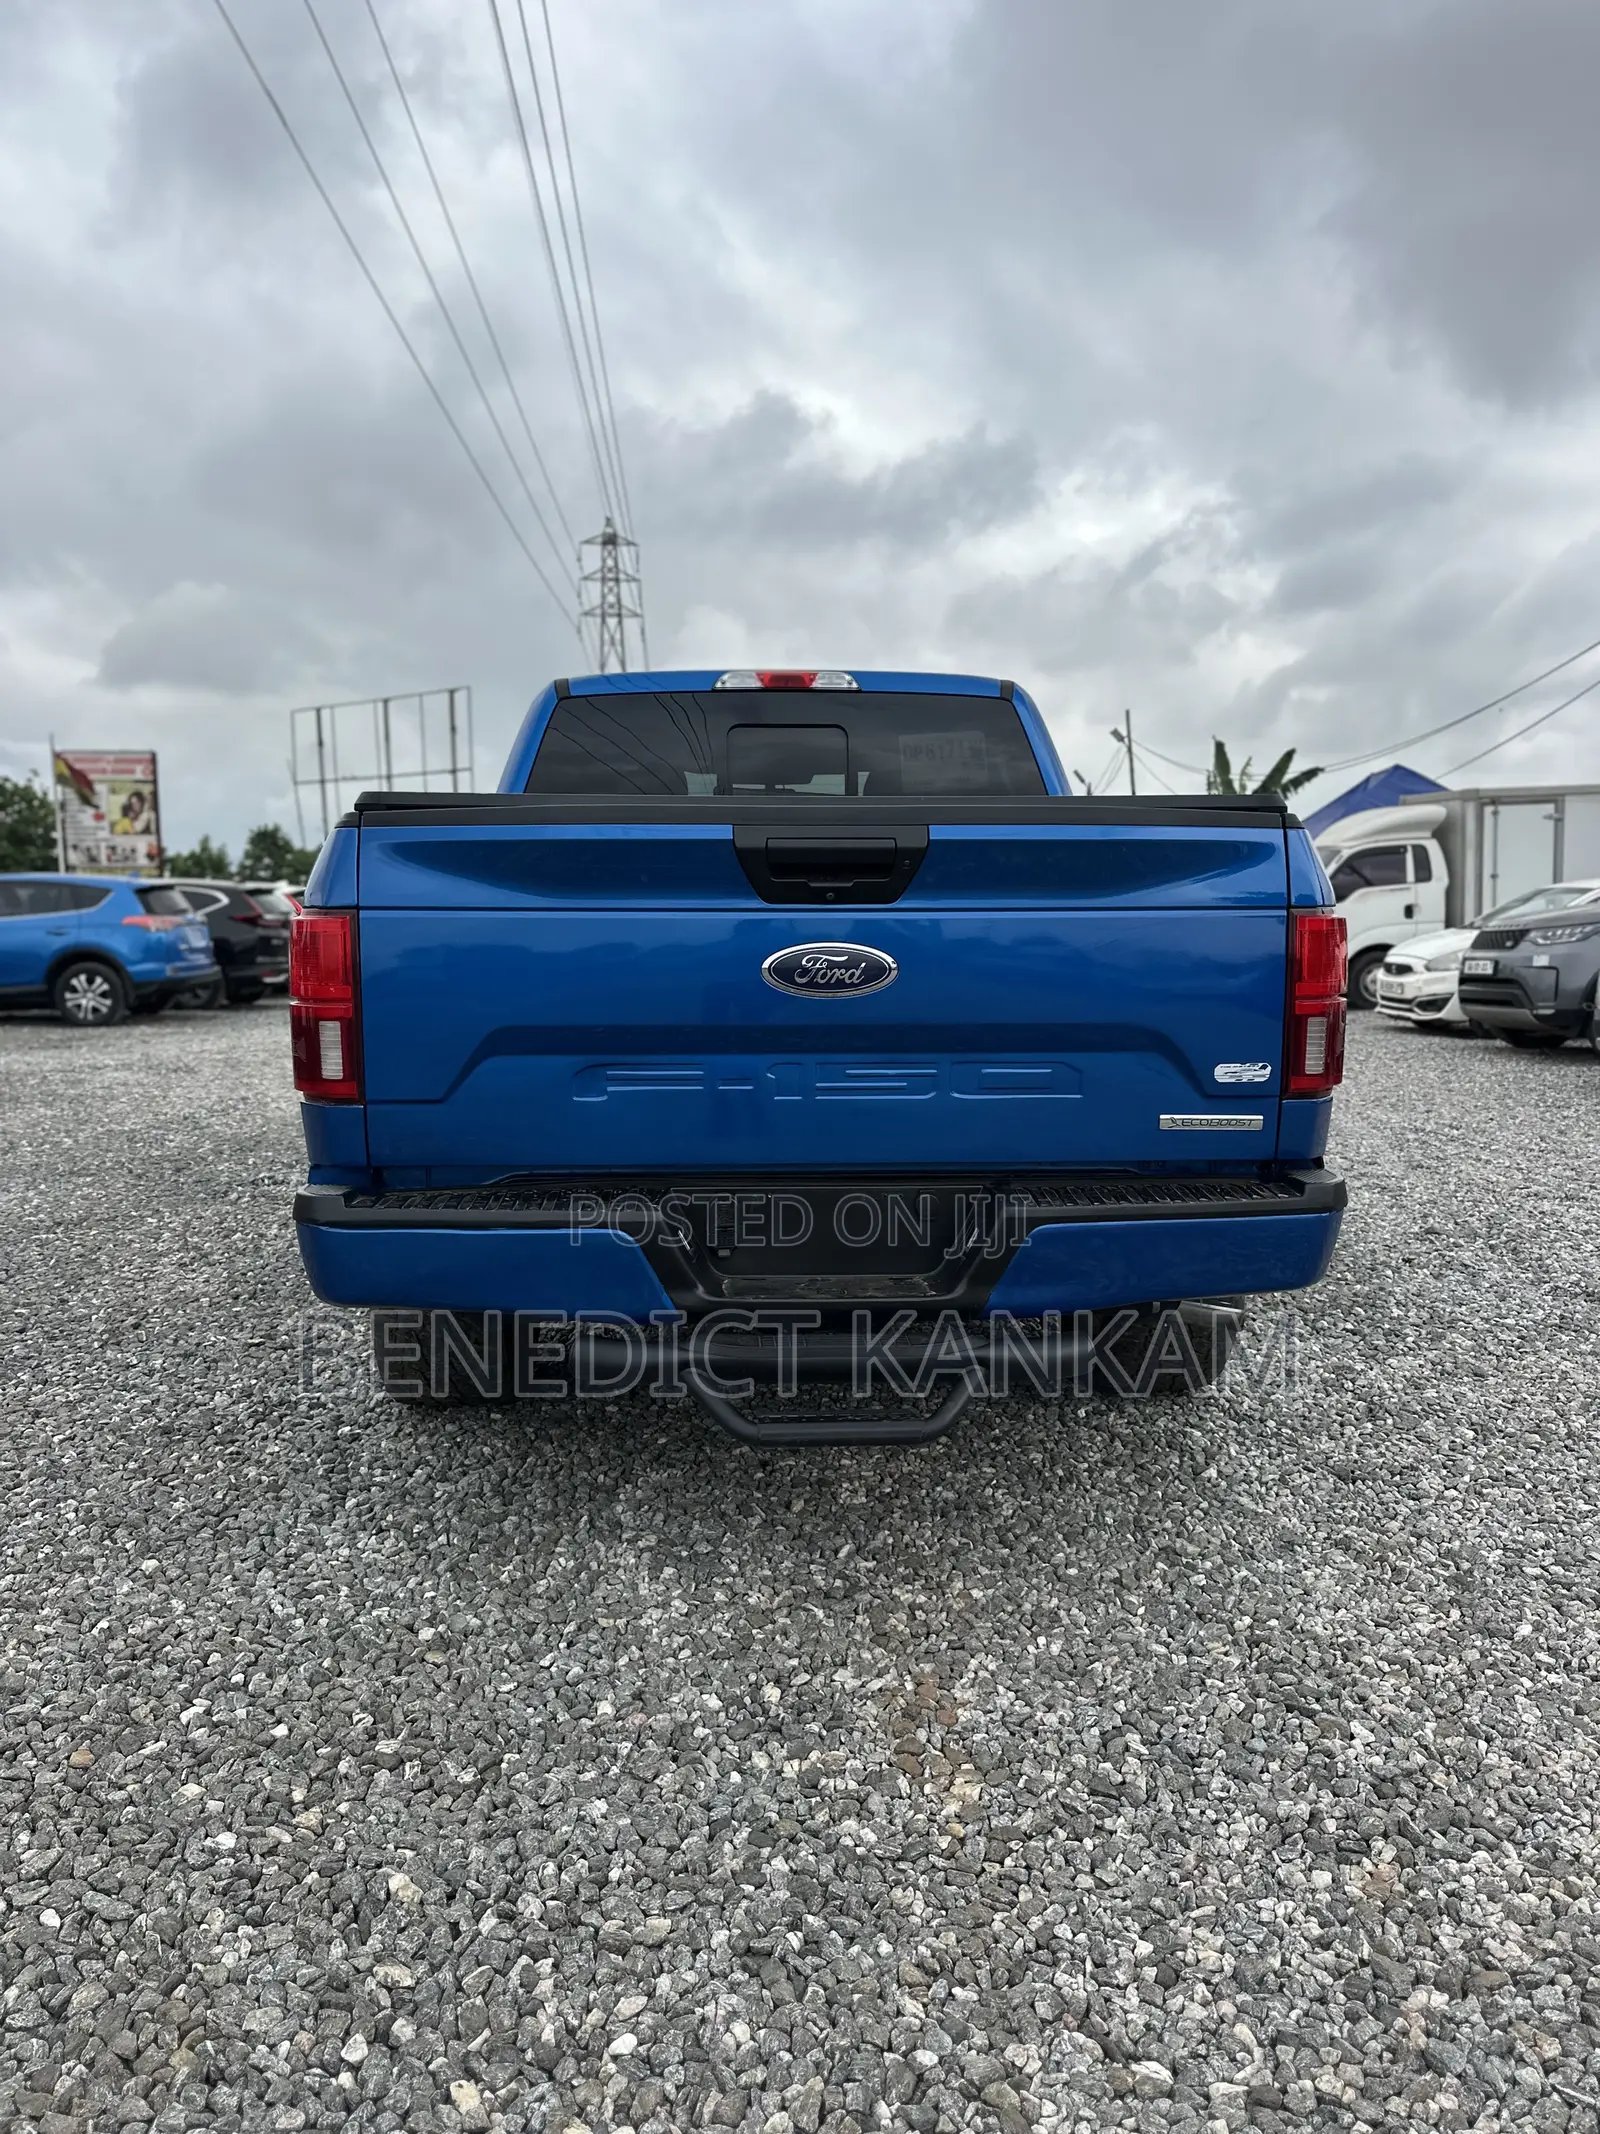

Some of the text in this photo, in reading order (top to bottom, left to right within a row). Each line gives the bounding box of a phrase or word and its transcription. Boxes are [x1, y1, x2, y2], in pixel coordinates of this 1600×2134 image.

[794, 954, 865, 984] Ford
[571, 1062, 1084, 1101] F-150
[1181, 1117, 1256, 1128] ECOBOOST
